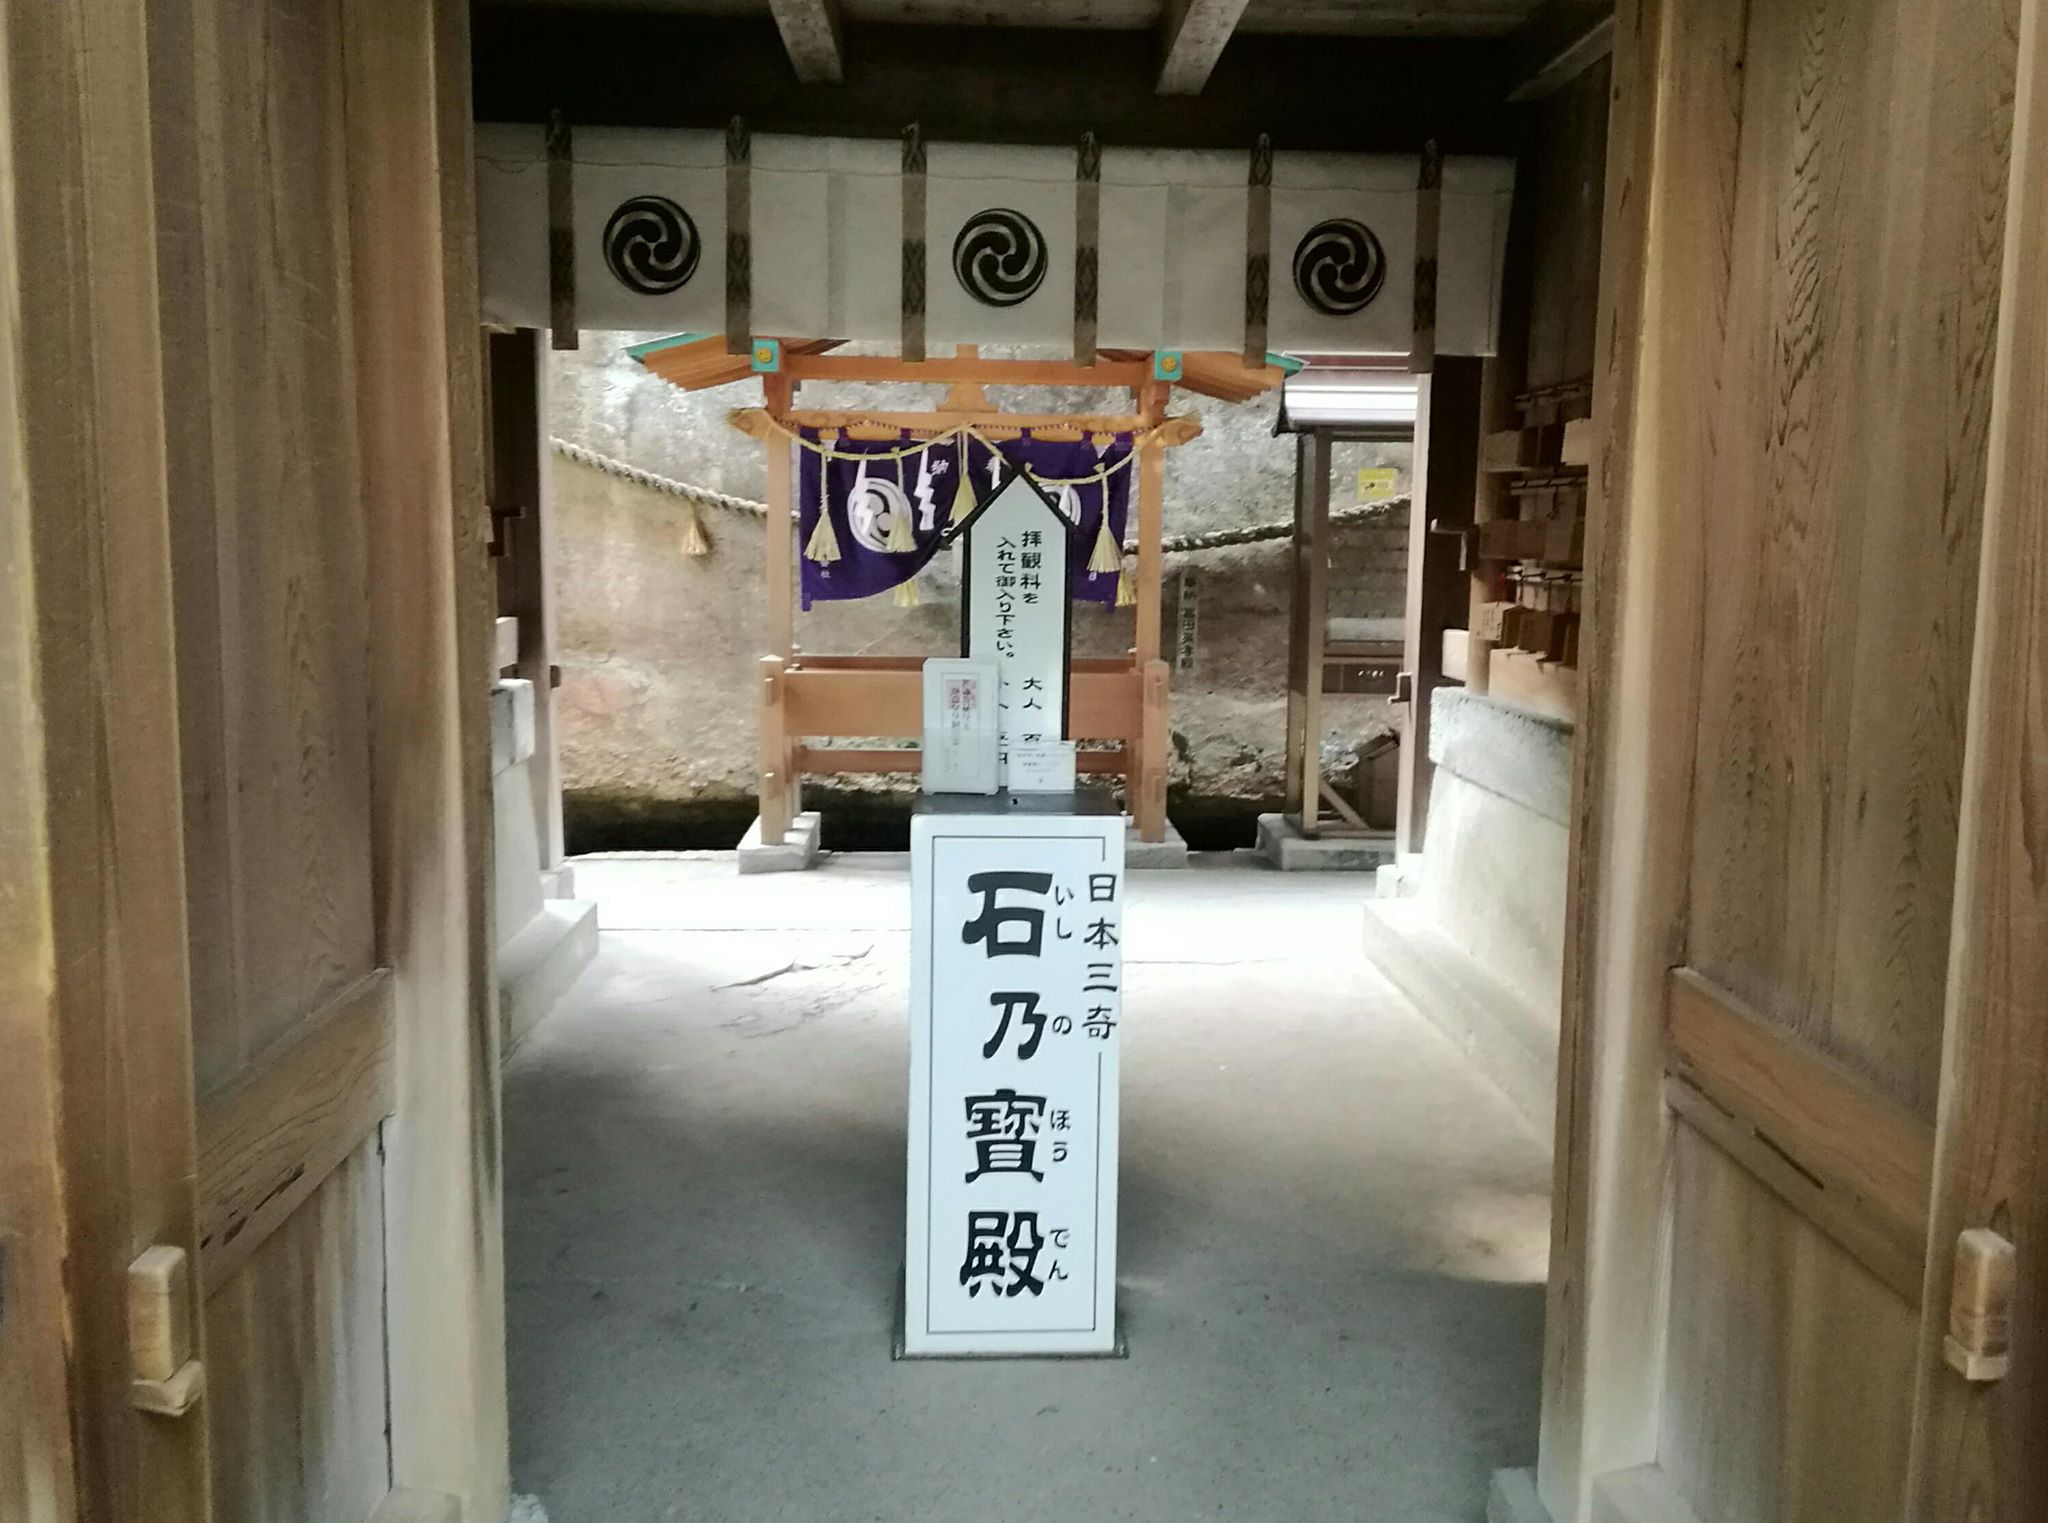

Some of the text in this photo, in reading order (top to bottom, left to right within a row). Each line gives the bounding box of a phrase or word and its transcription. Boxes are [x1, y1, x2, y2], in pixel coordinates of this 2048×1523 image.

[1020, 530, 1042, 604] 拝観料を
[1082, 873, 1119, 1040] 日本三奇
[1049, 885, 1074, 1280] いし の ほう でん
